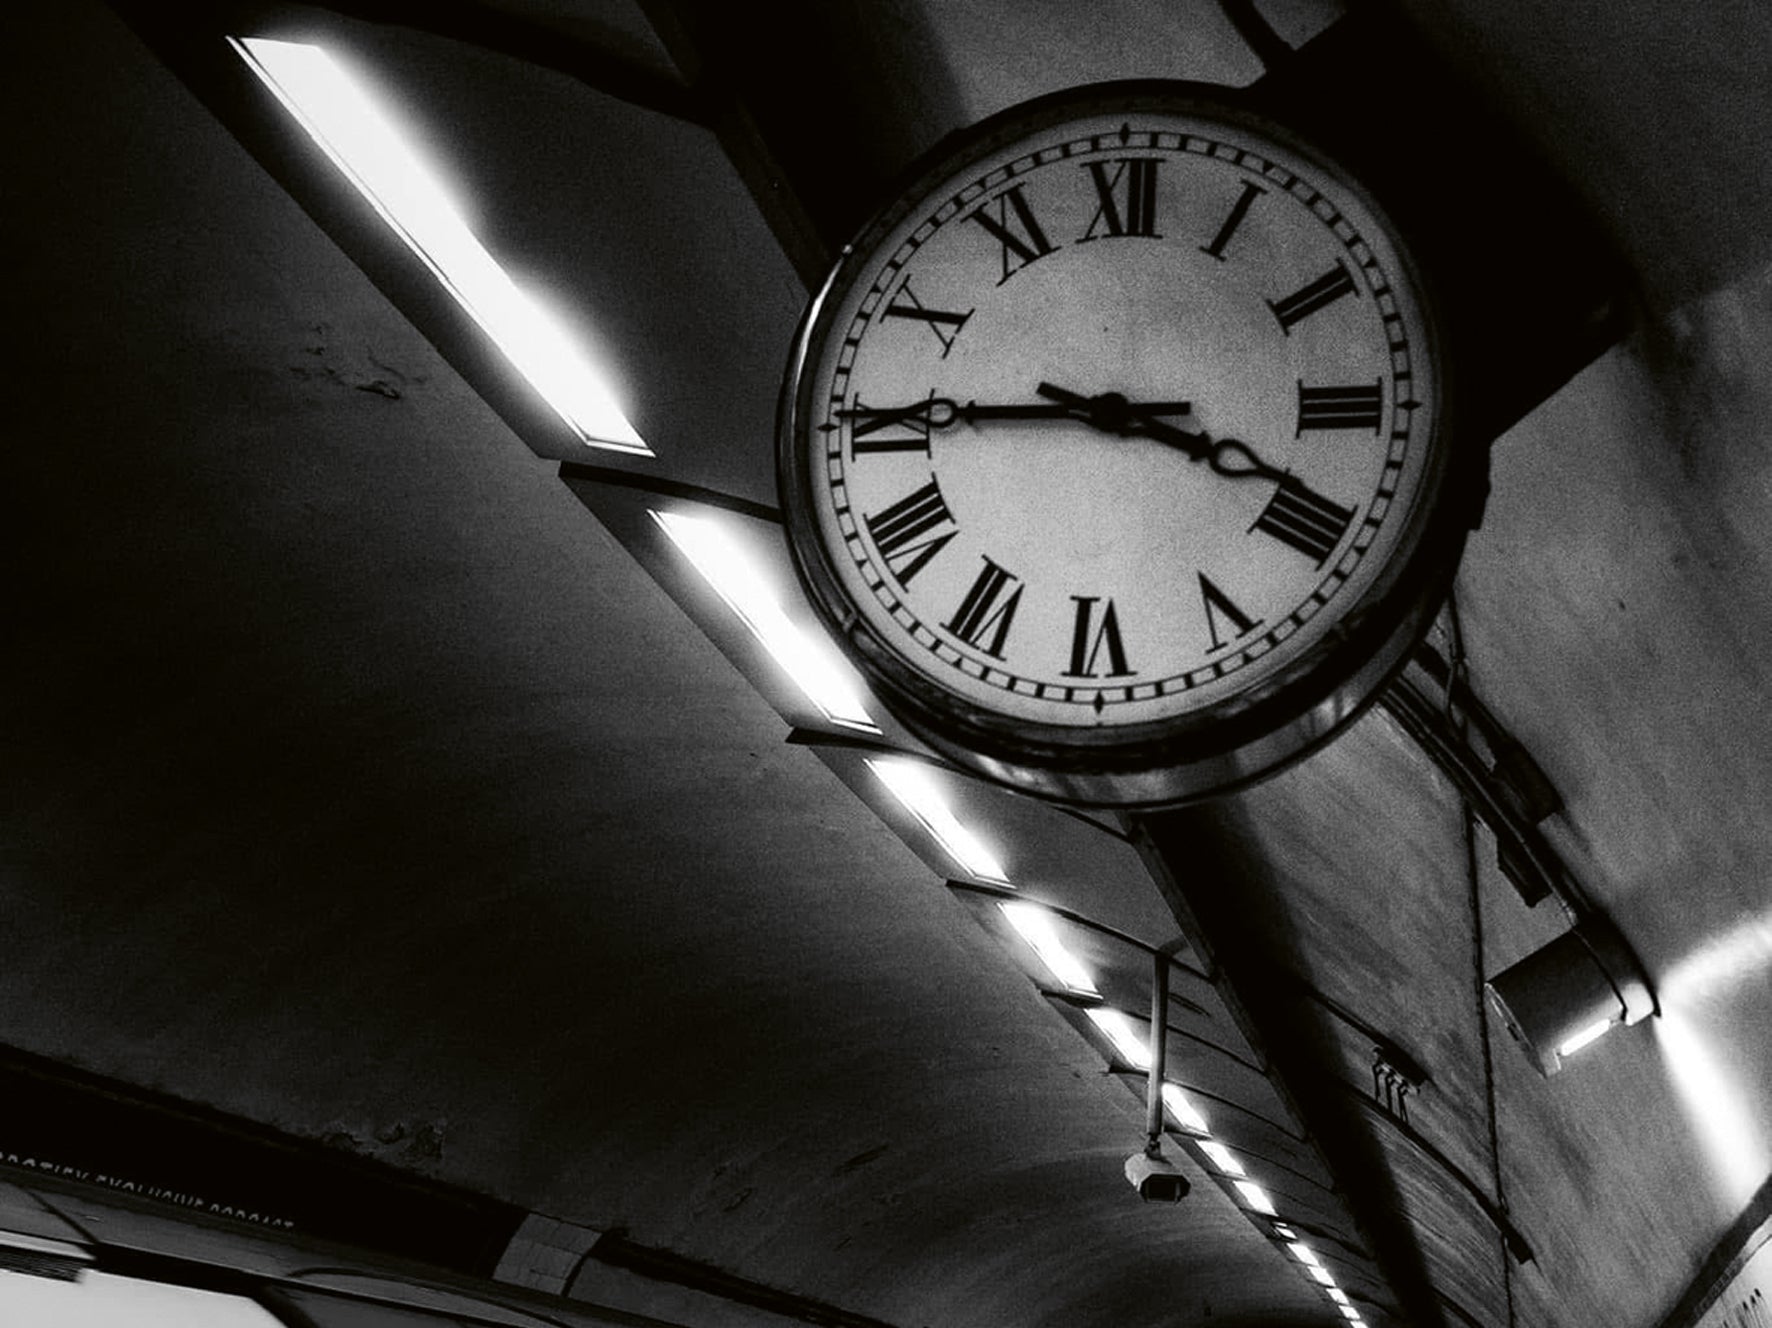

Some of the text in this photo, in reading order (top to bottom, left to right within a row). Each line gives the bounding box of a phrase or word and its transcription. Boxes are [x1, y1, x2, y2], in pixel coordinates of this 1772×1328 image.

[961, 183, 1061, 286] XI
[1077, 158, 1165, 243] XII
[1200, 179, 1266, 261] I
[880, 274, 974, 358] X
[1267, 258, 1359, 336] II
[852, 388, 935, 462] IX
[1296, 376, 1381, 438] III
[864, 472, 959, 592] VIII
[1247, 468, 1357, 571] IIII
[940, 554, 1024, 661] VII
[1062, 596, 1137, 677] VI
[1198, 571, 1265, 653] V
